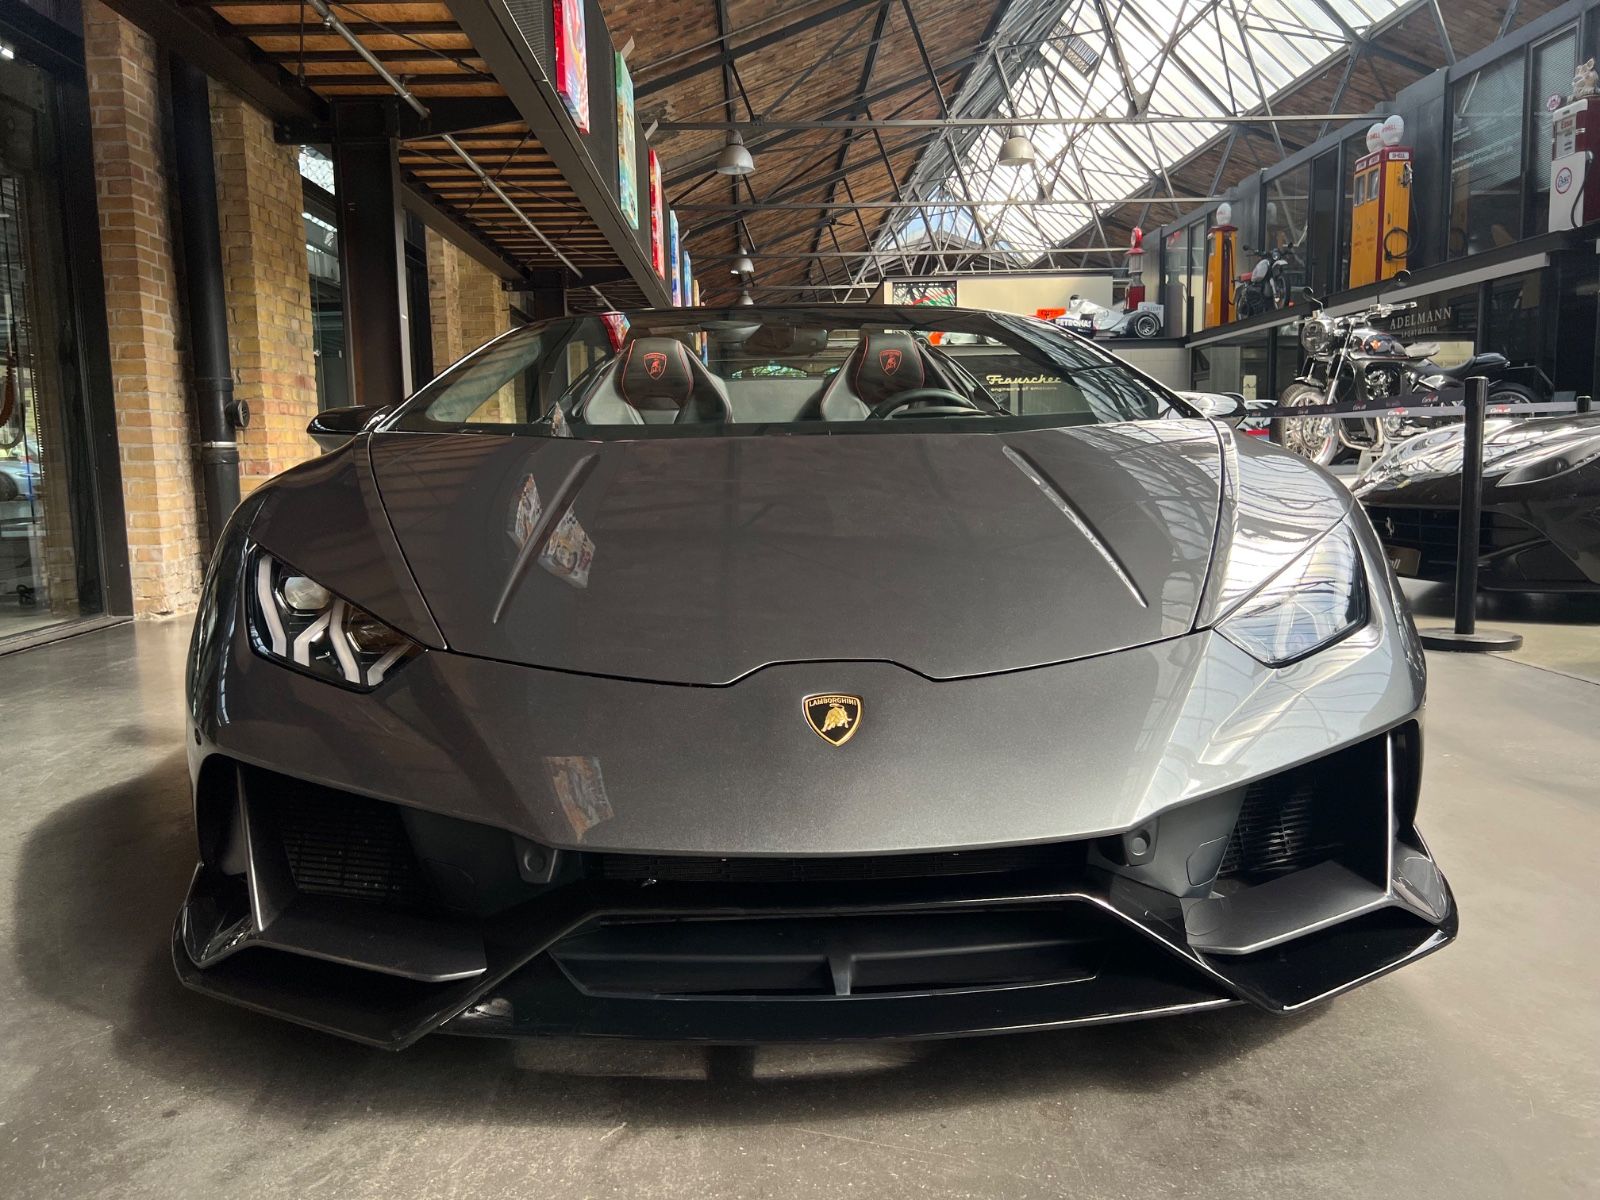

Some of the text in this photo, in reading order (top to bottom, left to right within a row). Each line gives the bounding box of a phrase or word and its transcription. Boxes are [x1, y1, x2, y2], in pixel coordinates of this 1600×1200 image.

[1055, 318, 1091, 327] PETRONAS
[1390, 307, 1452, 330] ADELMANN
[1401, 325, 1438, 338] SPORTWAGEN
[986, 374, 1061, 384] Frauscher
[809, 697, 857, 706] LAMBORGHINI
